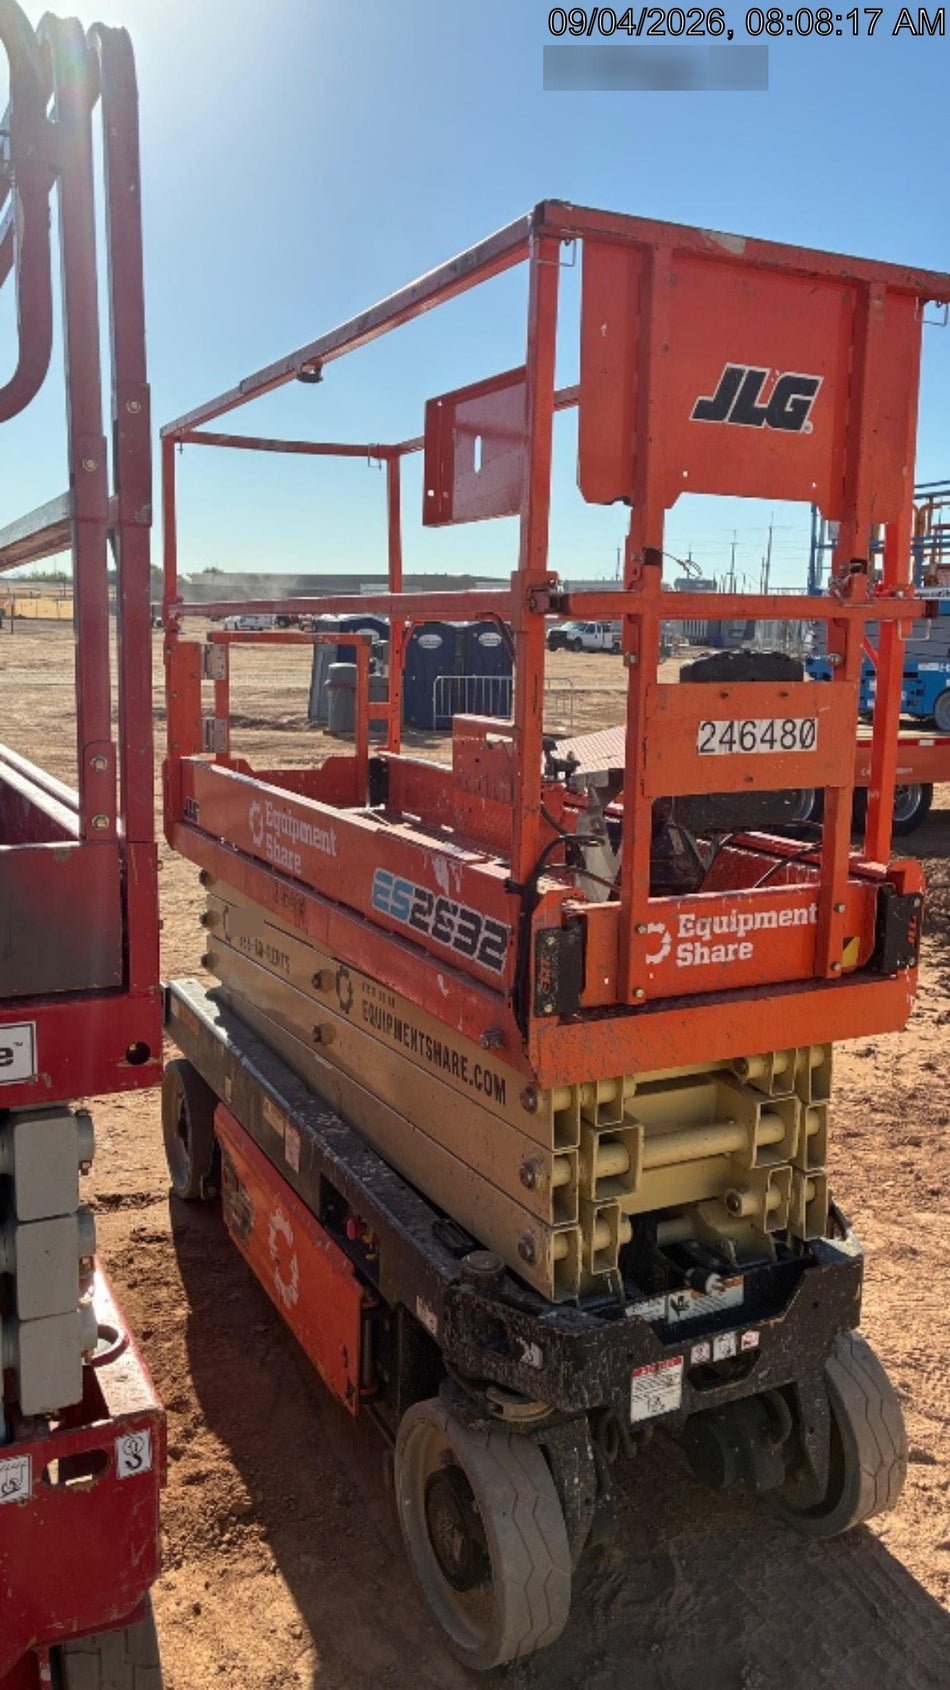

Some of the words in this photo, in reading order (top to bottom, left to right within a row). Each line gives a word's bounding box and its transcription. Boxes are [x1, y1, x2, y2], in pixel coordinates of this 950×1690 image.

[689, 362, 824, 434] JLG
[700, 718, 816, 753] 246480
[265, 800, 337, 857] Equipment
[266, 833, 302, 876] Share
[372, 867, 512, 976] ES2632
[677, 903, 818, 941] Equipment
[676, 941, 754, 967] Share
[361, 1000, 507, 1106] EQUIPMENTSHARE.COM
